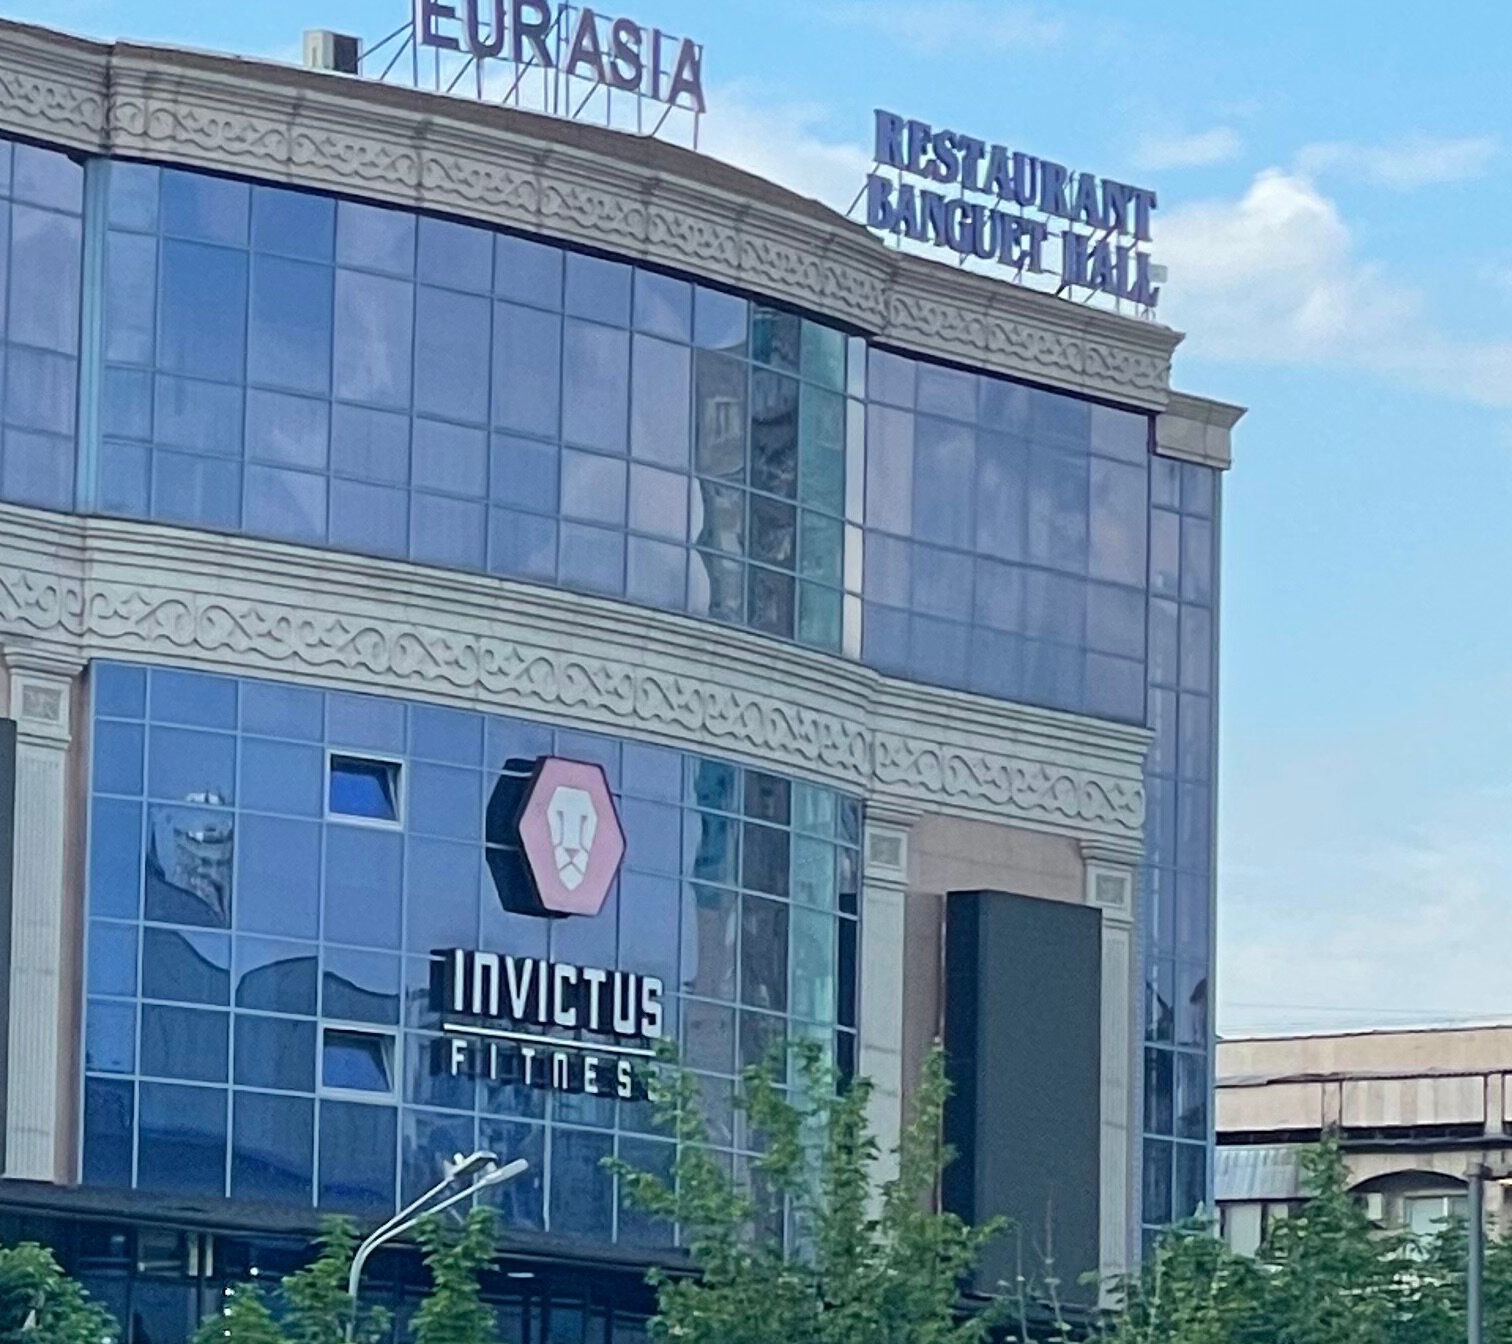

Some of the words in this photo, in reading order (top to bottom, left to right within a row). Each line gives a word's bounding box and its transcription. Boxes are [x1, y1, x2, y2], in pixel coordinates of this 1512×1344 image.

[874, 108, 1158, 242] RESTAURANT
[1061, 230, 1161, 308] HALL
[453, 948, 664, 1040] INVICTUS
